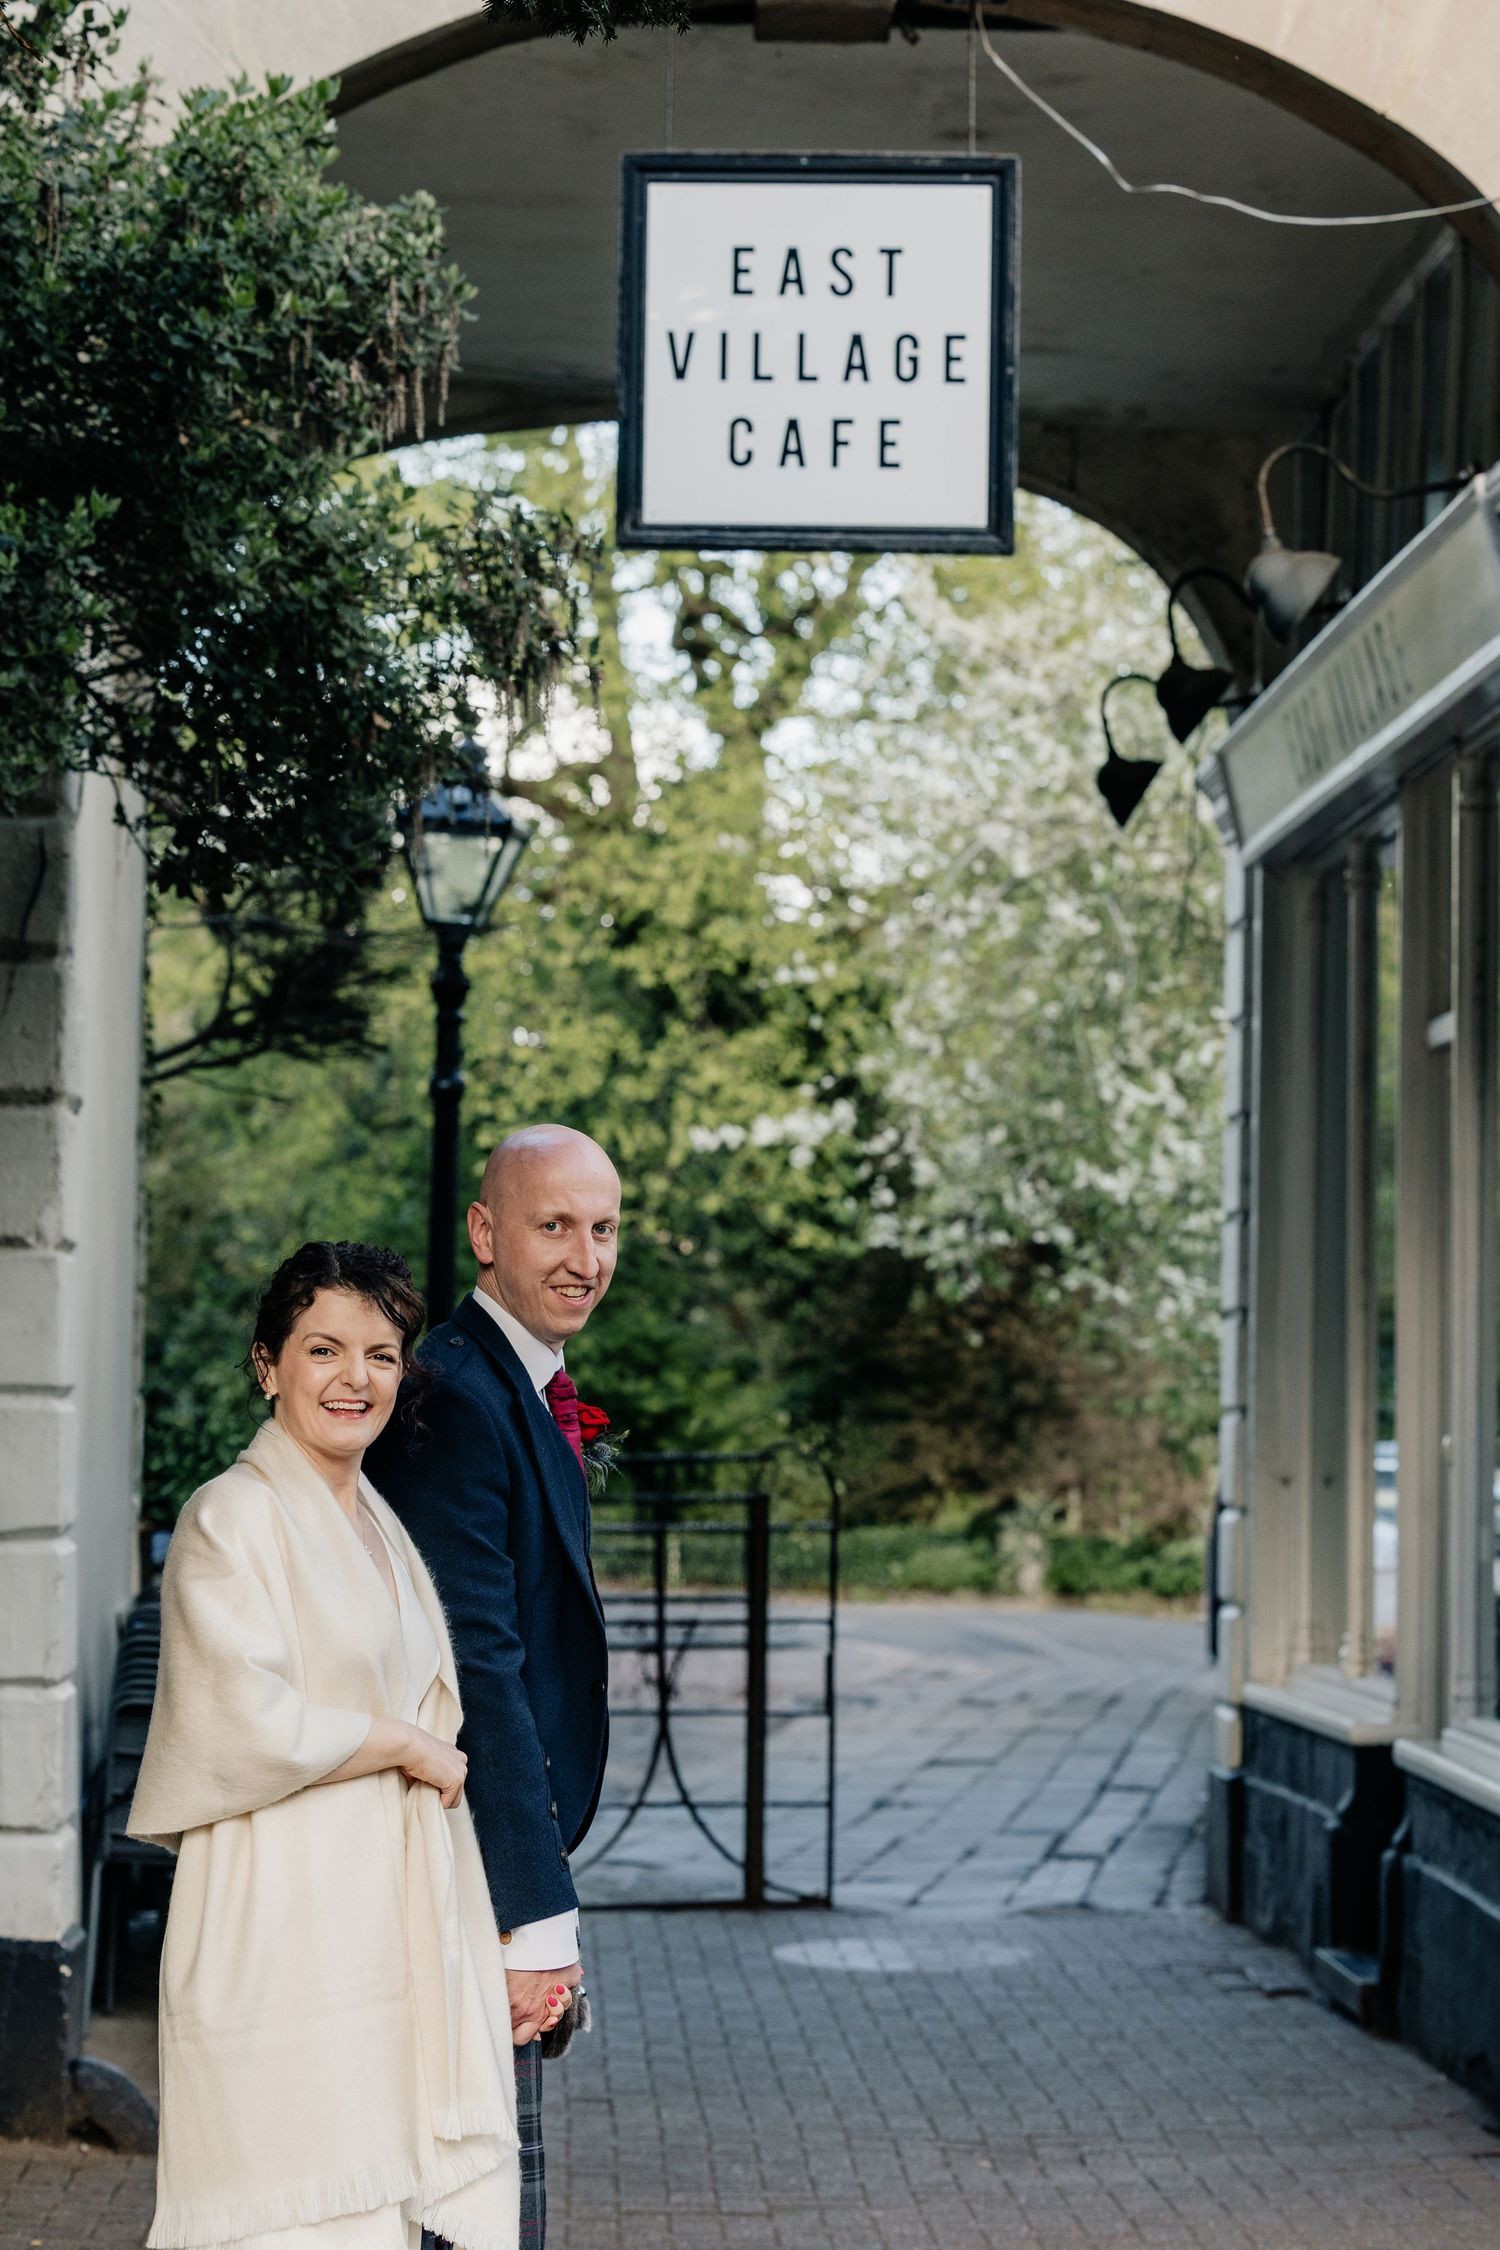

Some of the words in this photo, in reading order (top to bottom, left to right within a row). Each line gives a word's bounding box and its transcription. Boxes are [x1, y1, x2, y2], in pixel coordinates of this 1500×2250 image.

[732, 247, 903, 297] EAST
[668, 331, 967, 383] VILLAGE
[729, 417, 902, 468] CAFE
